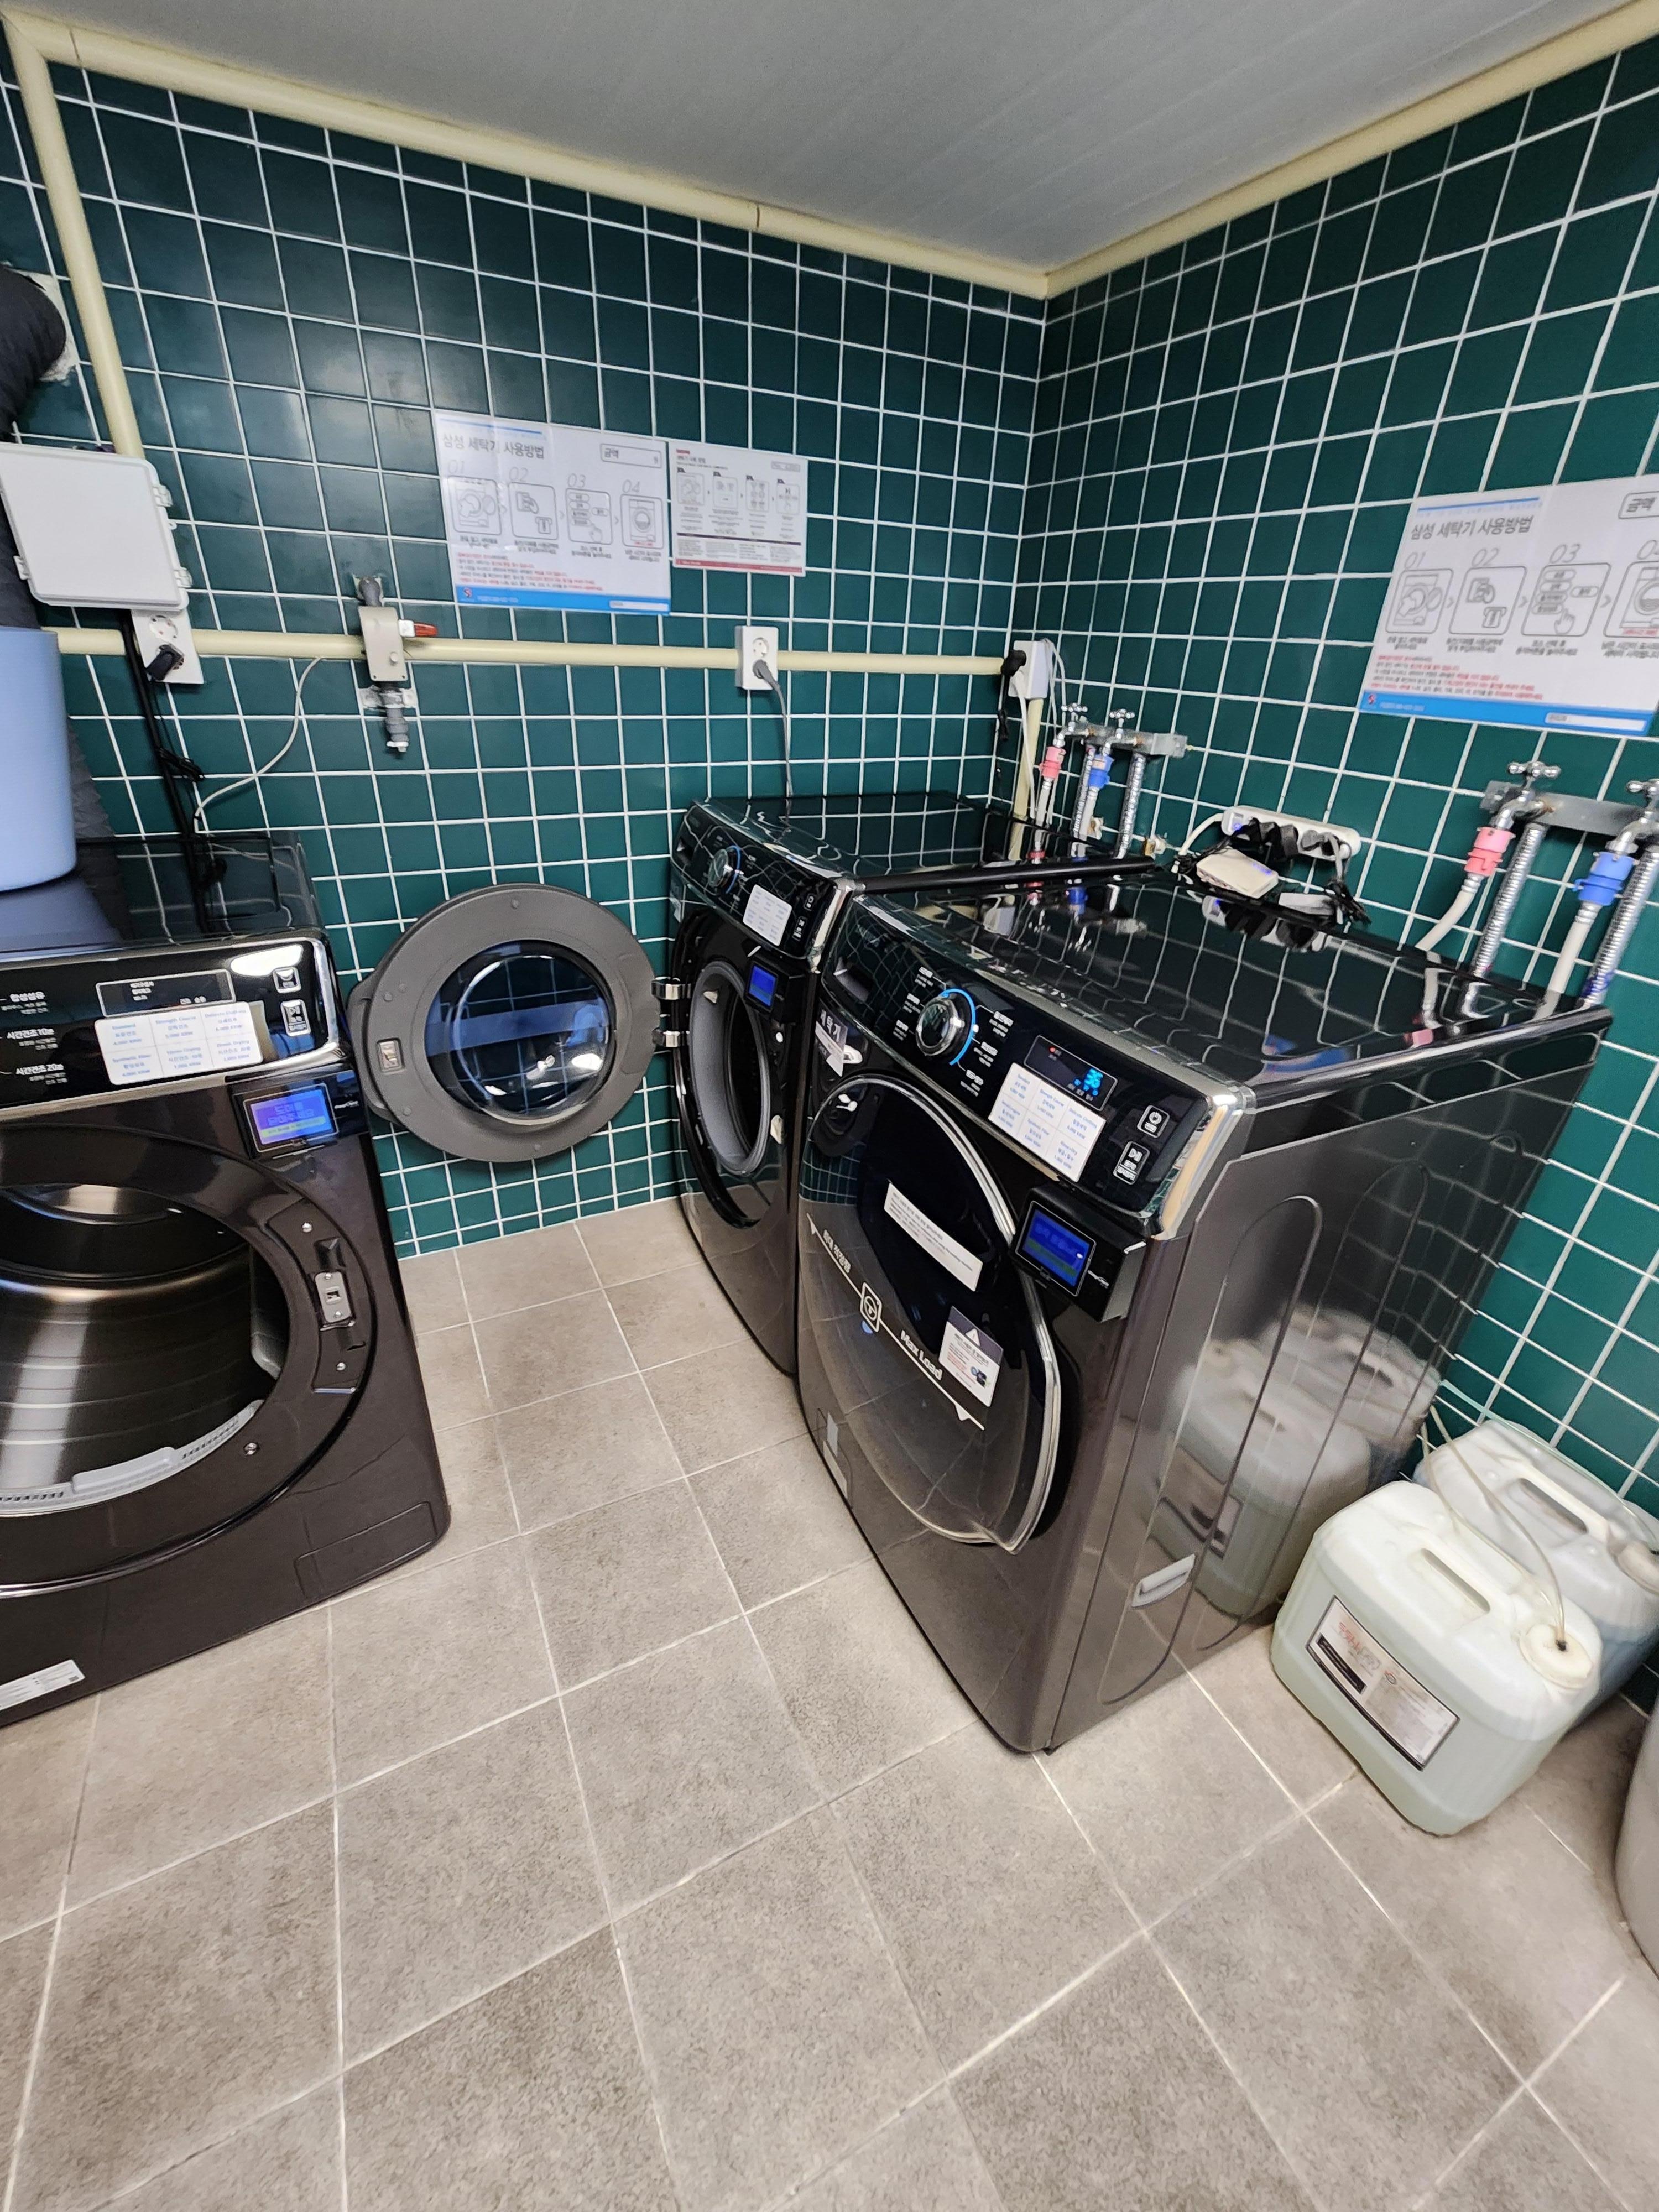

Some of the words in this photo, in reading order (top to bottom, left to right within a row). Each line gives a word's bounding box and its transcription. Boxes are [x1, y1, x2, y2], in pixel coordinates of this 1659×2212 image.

[443, 433, 465, 449] 삼성
[504, 441, 545, 459] 사용방법
[509, 466, 529, 482] 02
[568, 473, 586, 488] 03
[622, 479, 640, 493] 04
[1411, 523, 1436, 540] 삼성
[1437, 520, 1476, 538] 세탁기
[1478, 515, 1533, 535] 사용방법
[1405, 551, 1426, 570] 01
[1472, 547, 1500, 567] 02
[1550, 544, 1581, 564] 03
[820, 1009, 841, 1042] 세탁기
[900, 1329, 920, 1357] Max
[919, 1350, 943, 1381] Load
